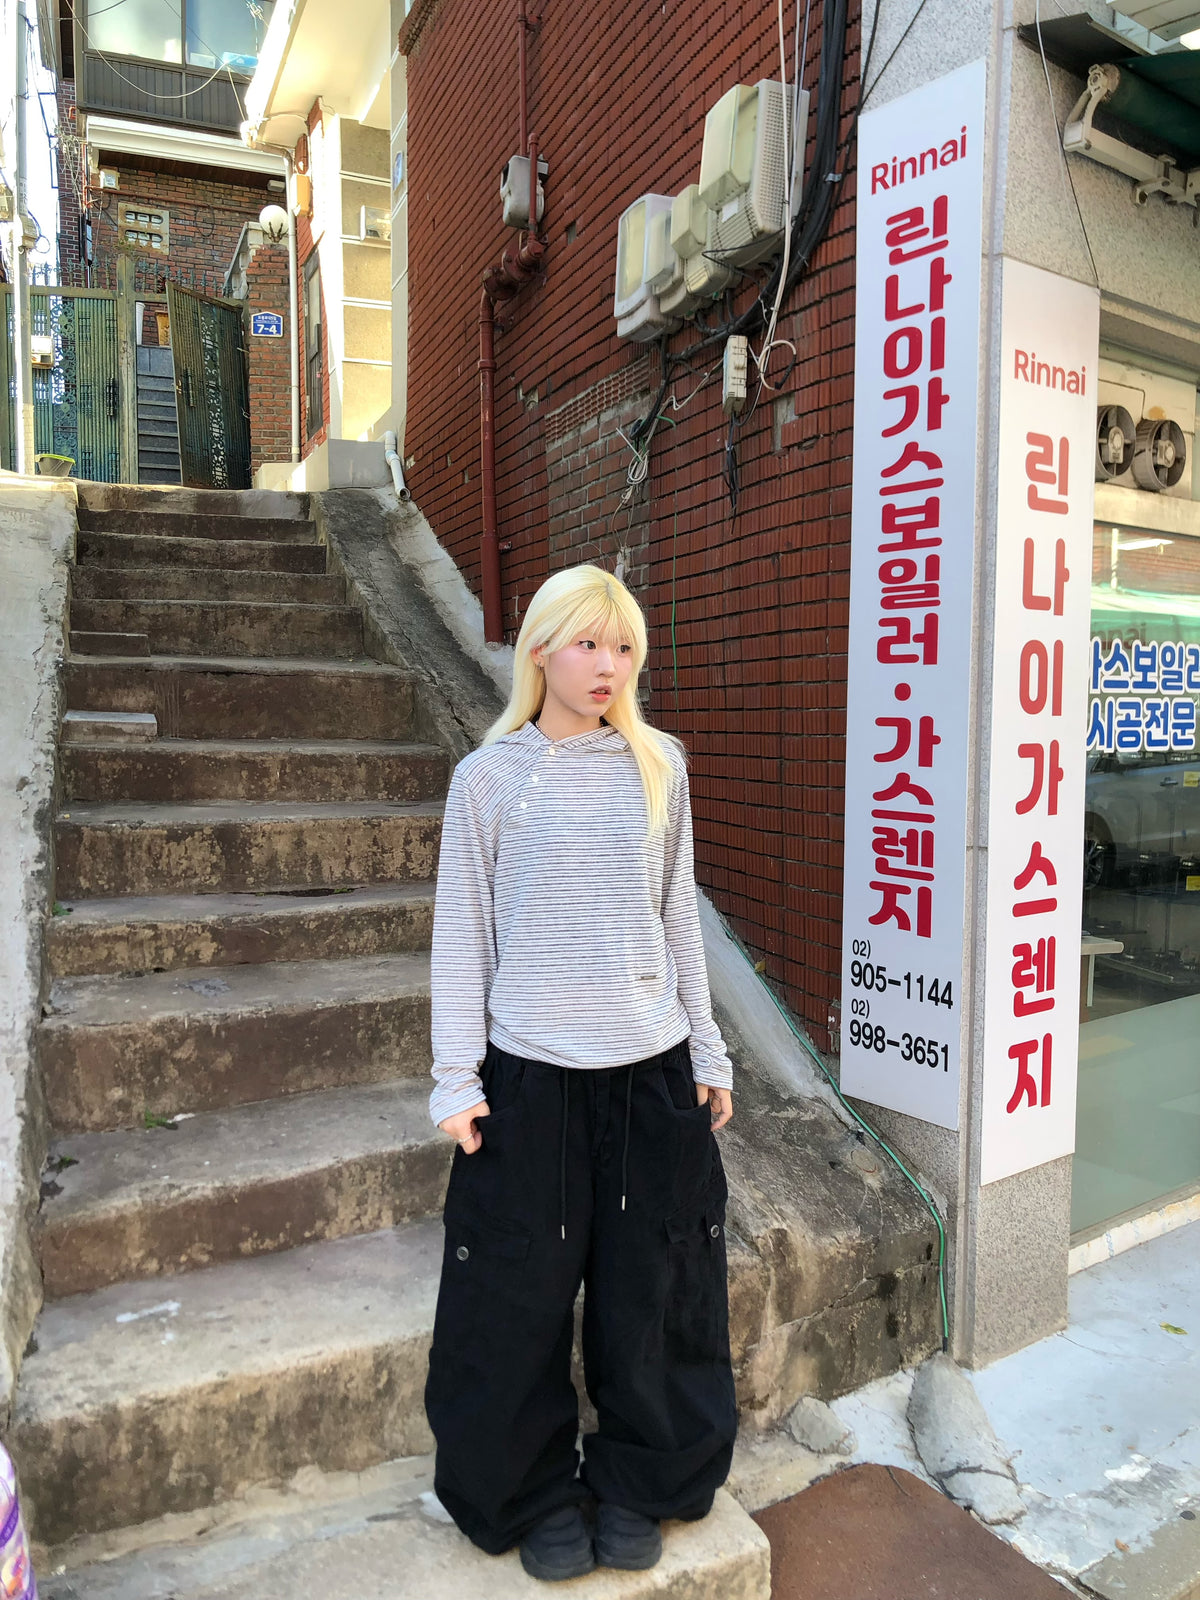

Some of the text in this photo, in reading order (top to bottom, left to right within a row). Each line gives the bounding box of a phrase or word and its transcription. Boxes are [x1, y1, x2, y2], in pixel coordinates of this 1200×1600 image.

[871, 125, 967, 195] Rinnai
[256, 324, 277, 334] 7-4
[1014, 349, 1087, 396] Rinnai
[868, 194, 953, 939] 린나이가스보일러·가스렌지
[1086, 700, 1195, 749] 시공전문
[1006, 431, 1070, 1114] 린나이가스렌지
[852, 939, 871, 960] 02)
[850, 960, 954, 1010] 905-1144
[851, 998, 870, 1019] 02)
[849, 1019, 949, 1073] 998-3651
